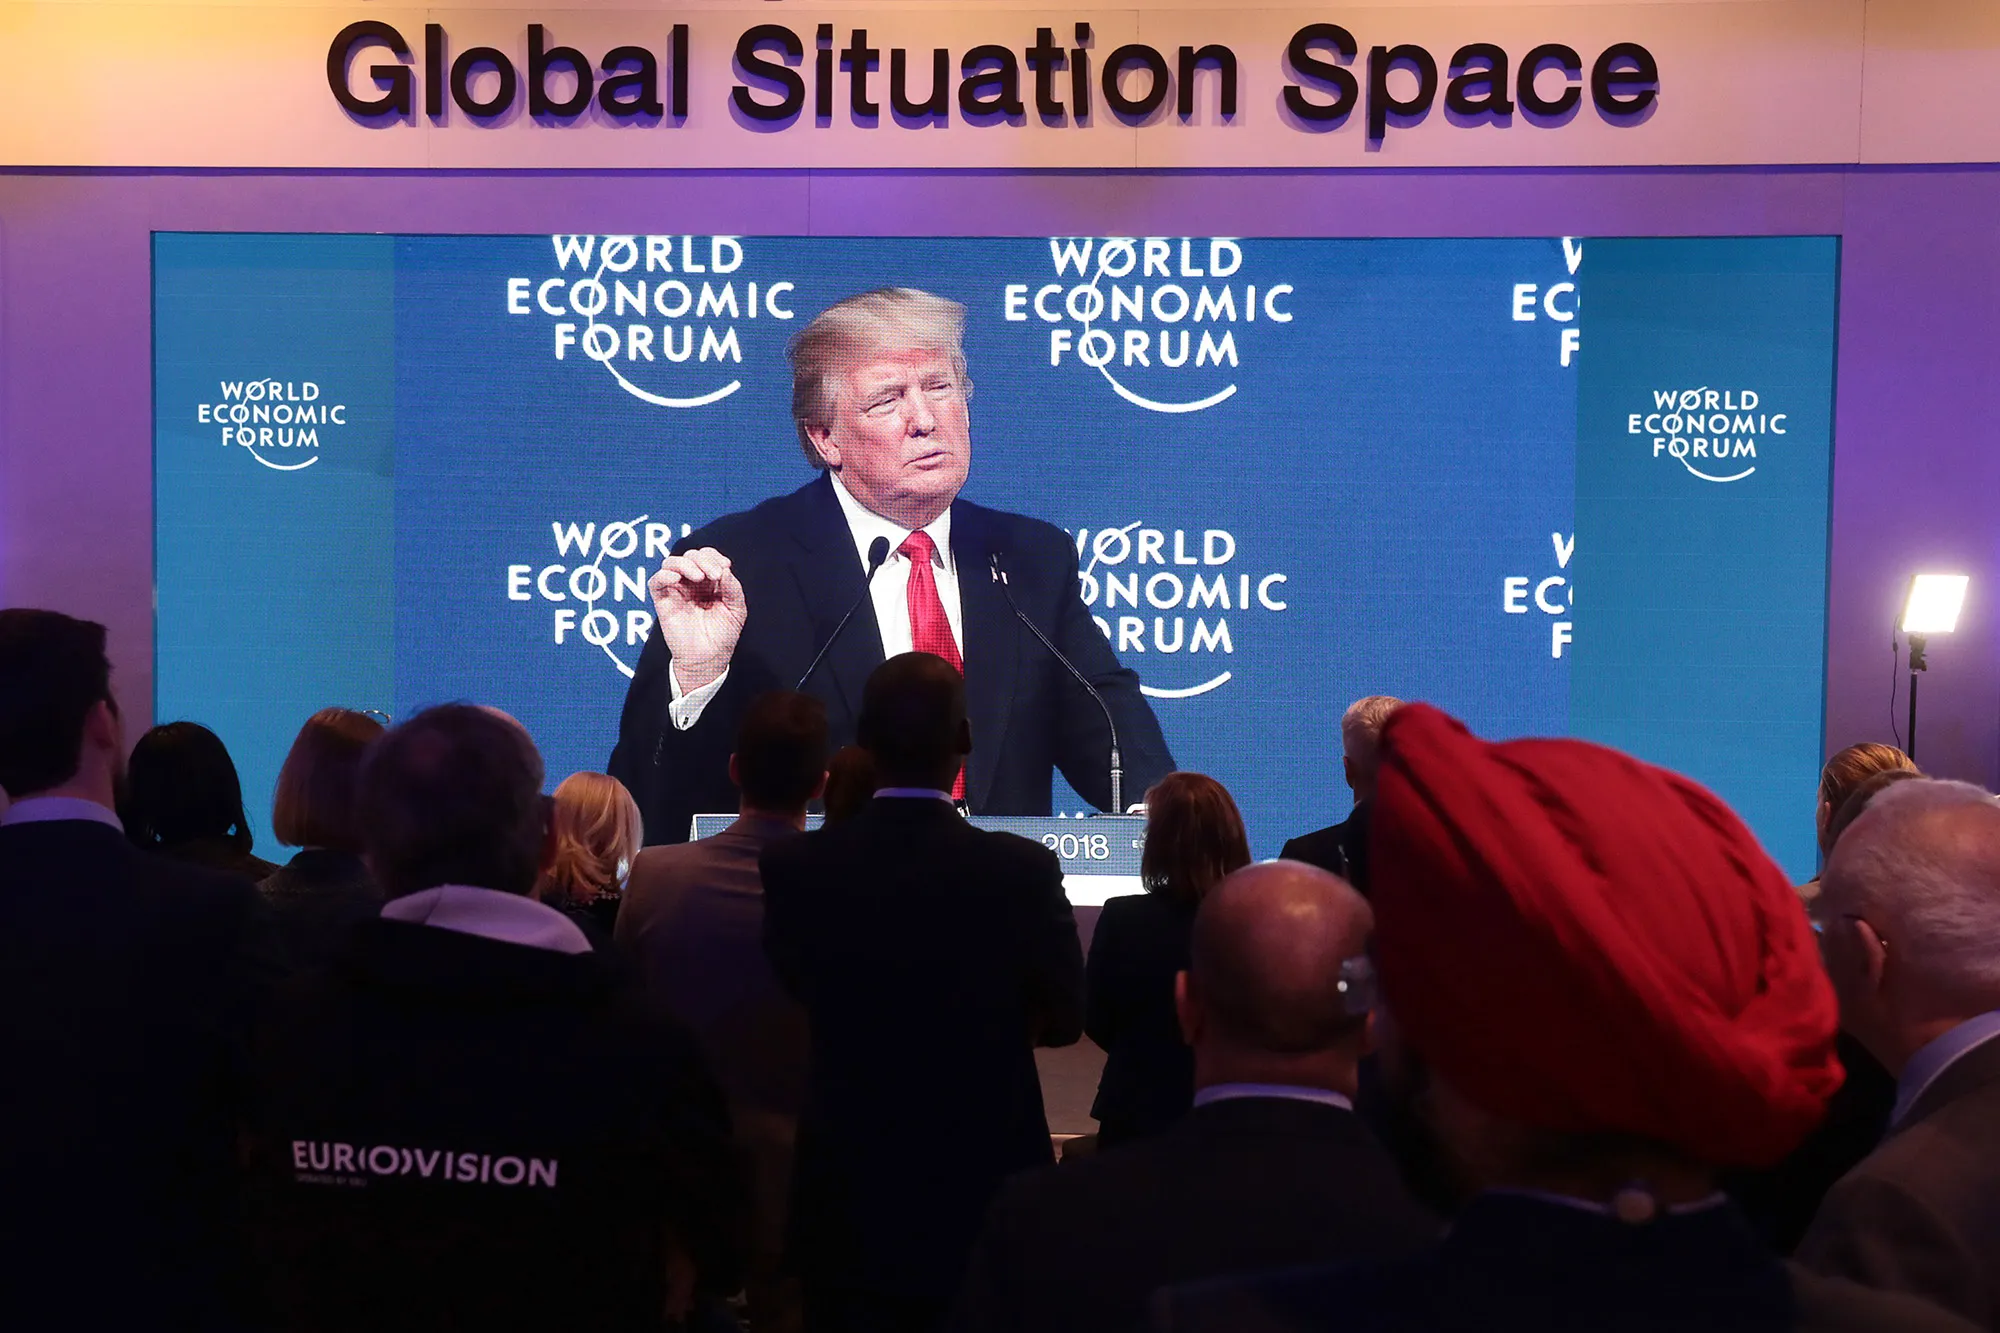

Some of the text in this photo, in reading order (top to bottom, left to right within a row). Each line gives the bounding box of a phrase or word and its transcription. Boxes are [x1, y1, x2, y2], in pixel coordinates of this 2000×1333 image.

[326, 20, 1658, 139] Global Situation Space
[552, 235, 744, 274] WORLD
[1050, 237, 1243, 278] WORLD
[507, 277, 795, 320] ECONOMIC
[1004, 282, 1294, 324] ECONOMIC
[554, 323, 743, 363] FORUM
[1050, 329, 1239, 369] FORUM
[221, 381, 320, 401] WORLD
[1653, 390, 1759, 411] WORLD
[198, 403, 346, 425] ECONOMIC
[1628, 413, 1787, 435] ECONOMIC
[222, 426, 319, 447] FORUM
[1652, 437, 1757, 458] FORUM
[552, 521, 691, 558] WOR
[507, 564, 647, 602] ECON
[1077, 572, 1288, 611] ONOMIC
[554, 609, 653, 645] FOR
[1091, 615, 1234, 654] RUM
[1042, 833, 1110, 860] 2018
